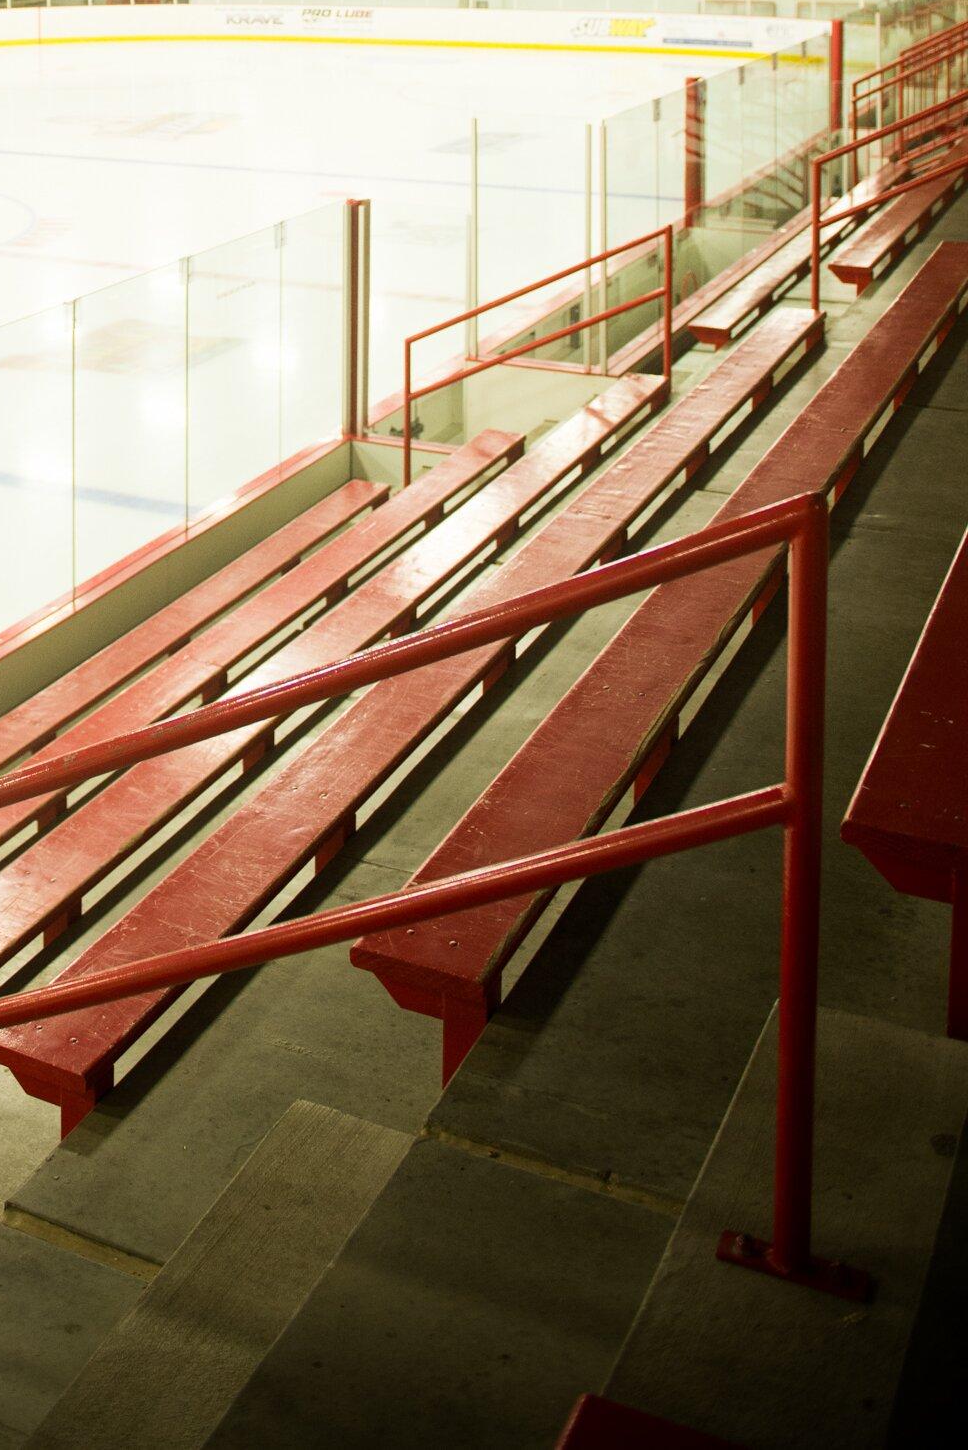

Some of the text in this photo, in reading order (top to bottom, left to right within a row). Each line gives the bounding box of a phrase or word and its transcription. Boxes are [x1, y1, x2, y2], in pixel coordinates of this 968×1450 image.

[225, 13, 283, 26] KRAVE
[302, 8, 331, 18] PRO
[572, 17, 656, 38] SUBWAY
